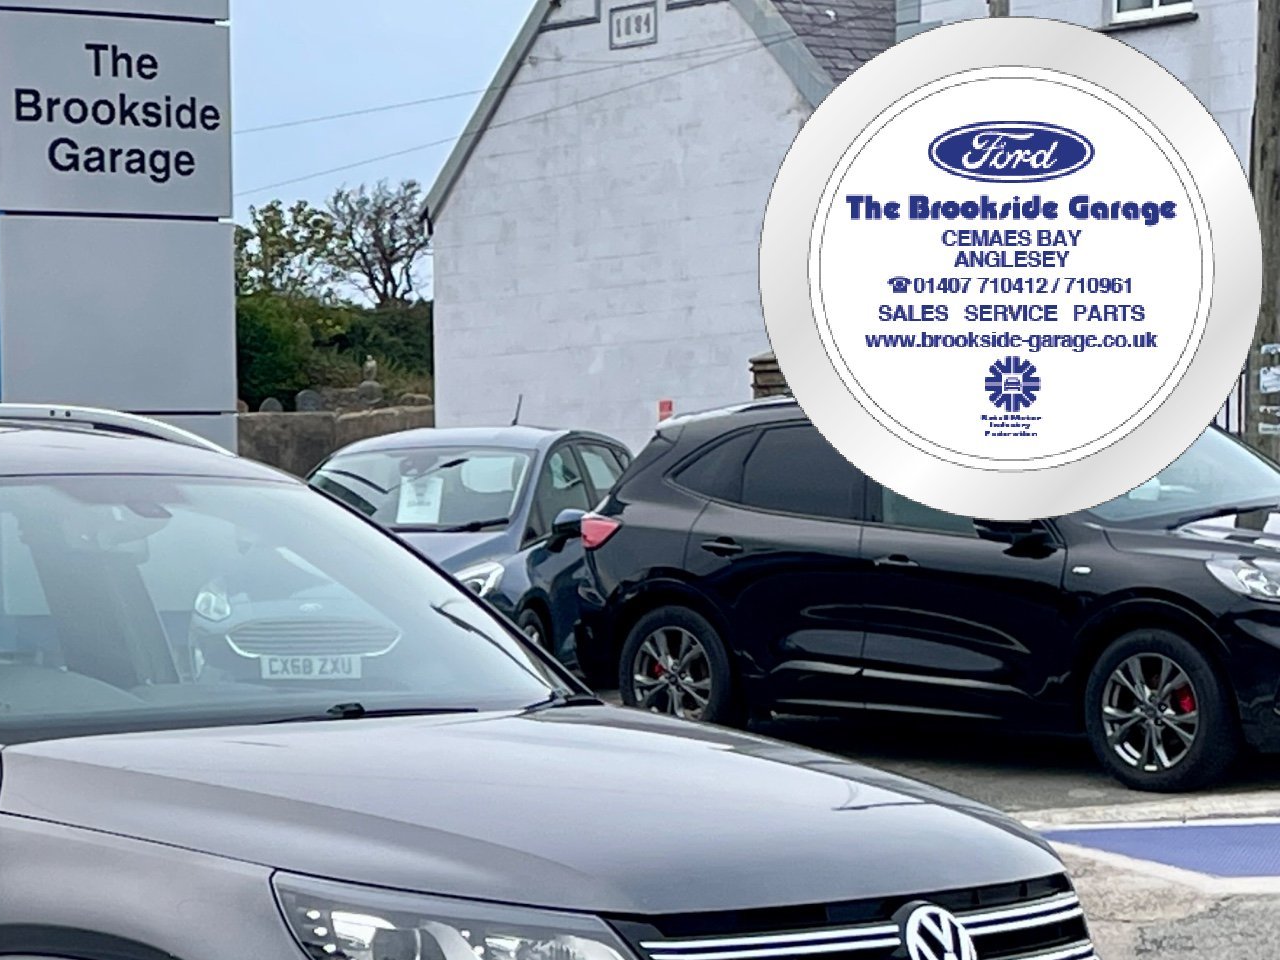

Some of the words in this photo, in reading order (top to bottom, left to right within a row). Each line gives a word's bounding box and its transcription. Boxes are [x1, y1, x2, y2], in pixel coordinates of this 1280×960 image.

[84, 43, 158, 80] The
[14, 87, 221, 131] Brookside
[48, 137, 196, 183] Garage
